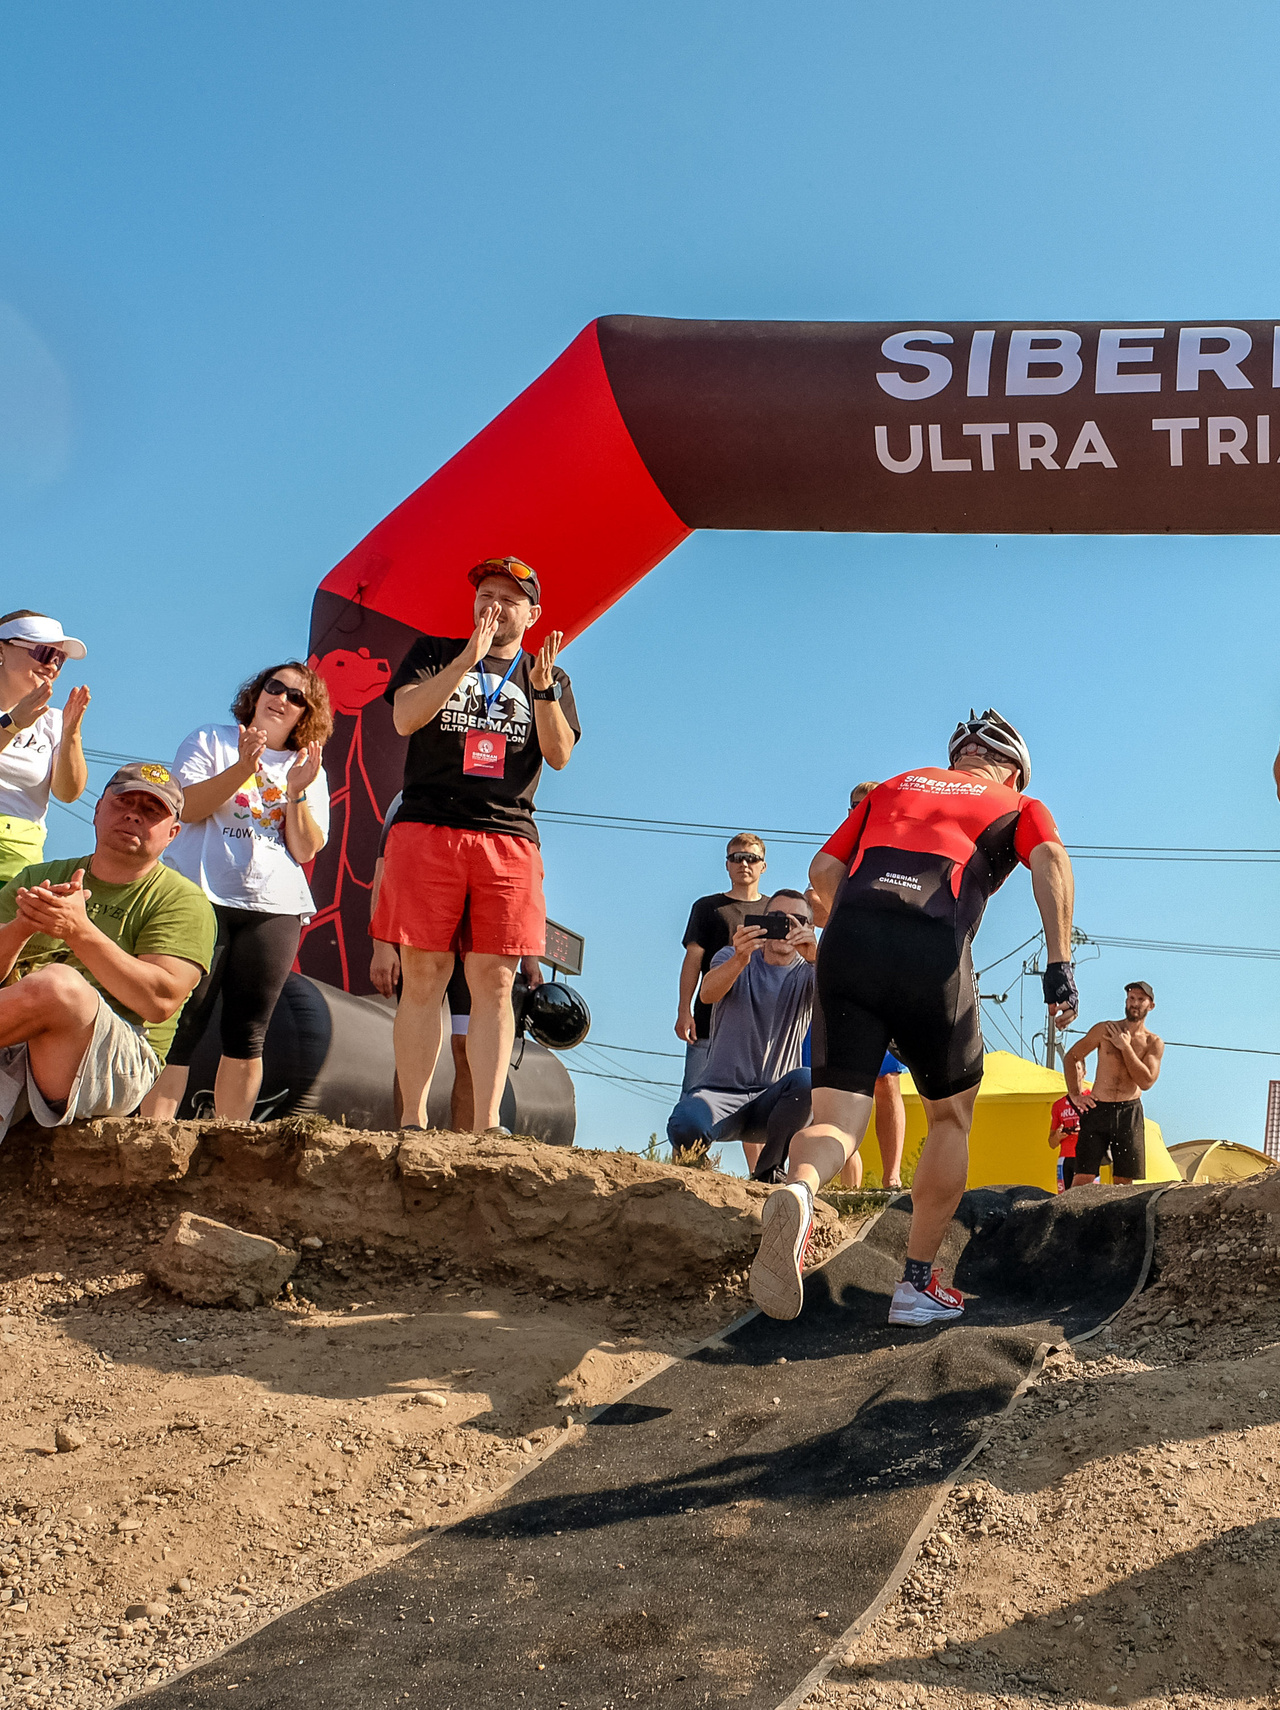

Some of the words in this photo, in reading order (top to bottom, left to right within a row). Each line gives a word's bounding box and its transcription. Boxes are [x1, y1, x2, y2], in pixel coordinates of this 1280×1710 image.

[874, 420, 1118, 474] ULTRA
[440, 723, 468, 733] ULTRA
[441, 710, 527, 736] SIBERMAN
[904, 775, 988, 791] SIBERMAN
[878, 876, 922, 891] CHALLENGE
[885, 871, 919, 883] SIBERIAN
